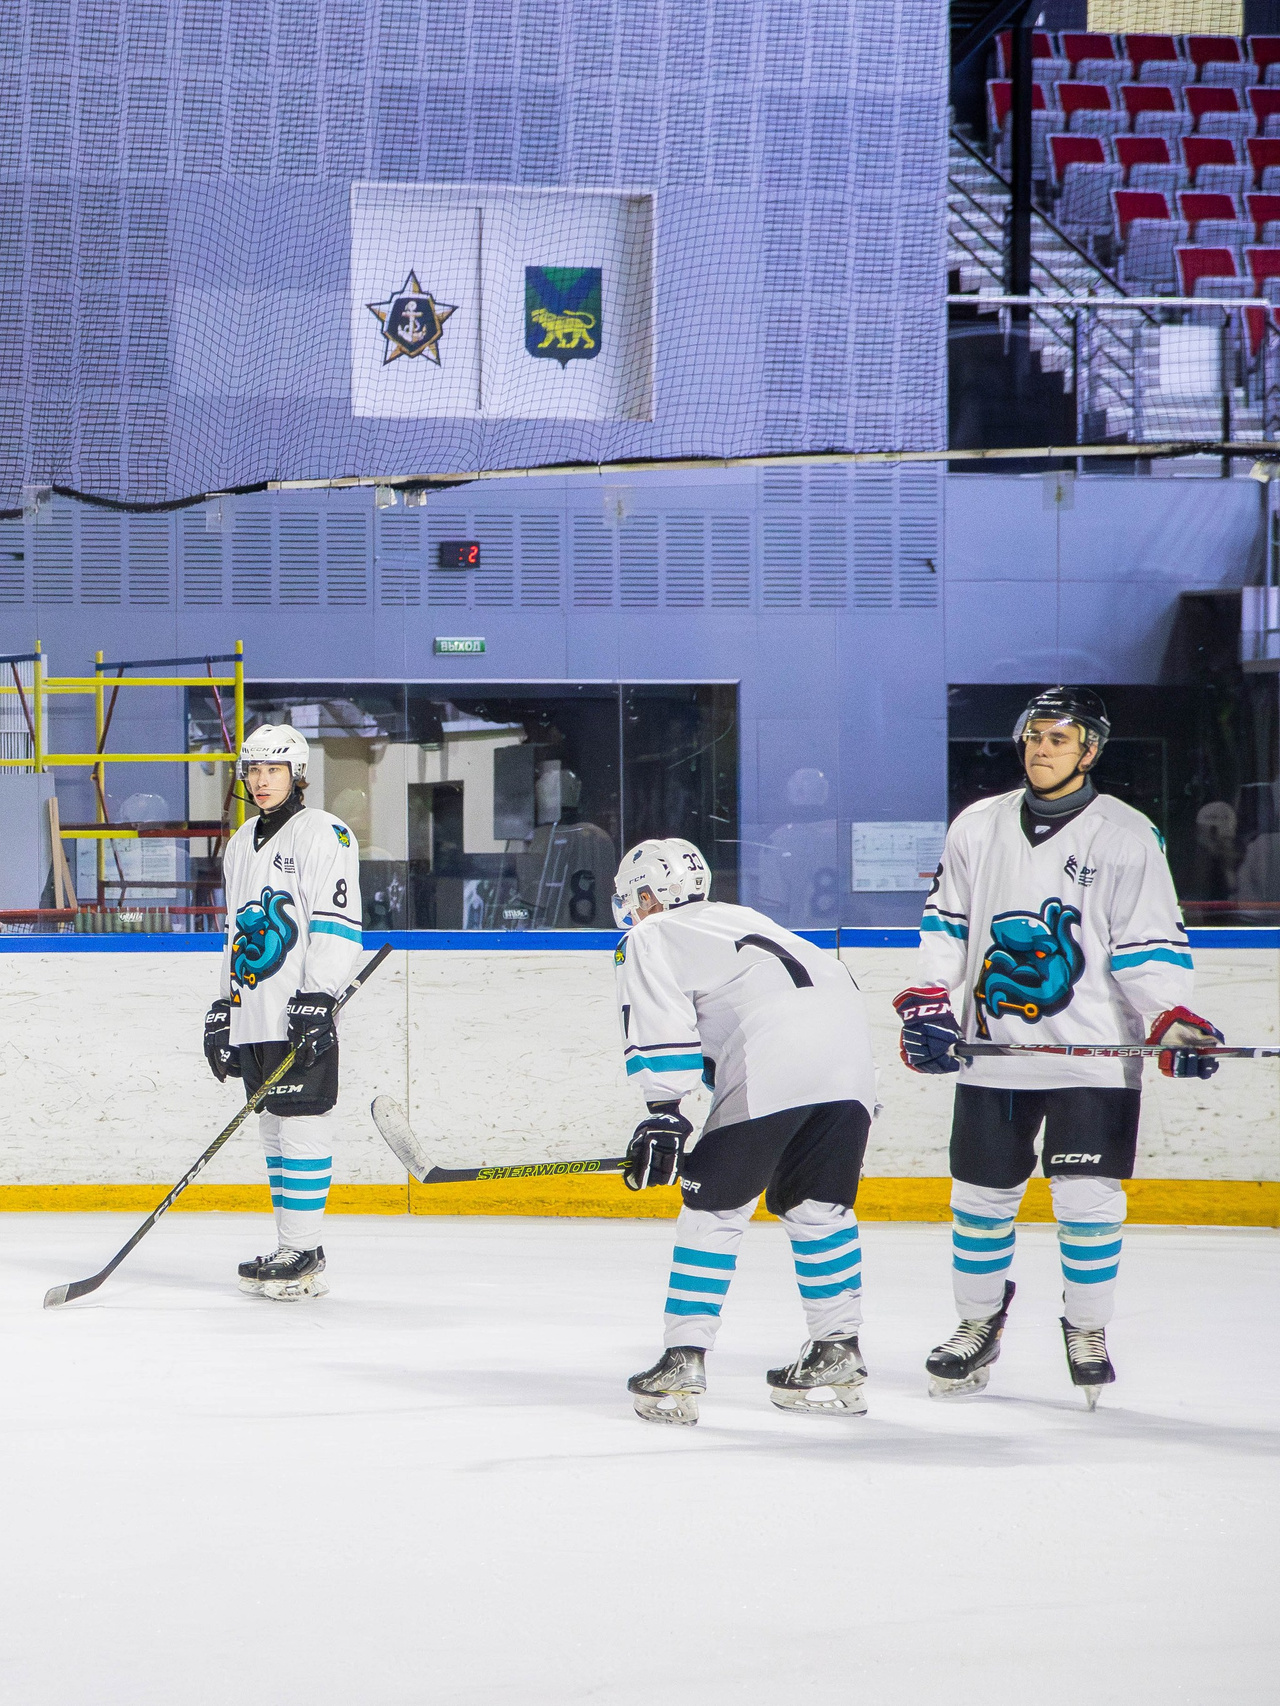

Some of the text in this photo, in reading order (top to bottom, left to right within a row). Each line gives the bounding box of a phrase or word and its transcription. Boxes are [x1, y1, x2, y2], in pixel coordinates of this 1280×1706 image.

[440, 641, 481, 652] ВЫХОД
[333, 878, 348, 908] 8
[286, 1004, 328, 1017] AUER
[1083, 1048, 1161, 1058] JETSPEE
[267, 1084, 304, 1095] CCM
[1050, 1153, 1102, 1165] CCM
[475, 1159, 601, 1182] SHERWOOD
